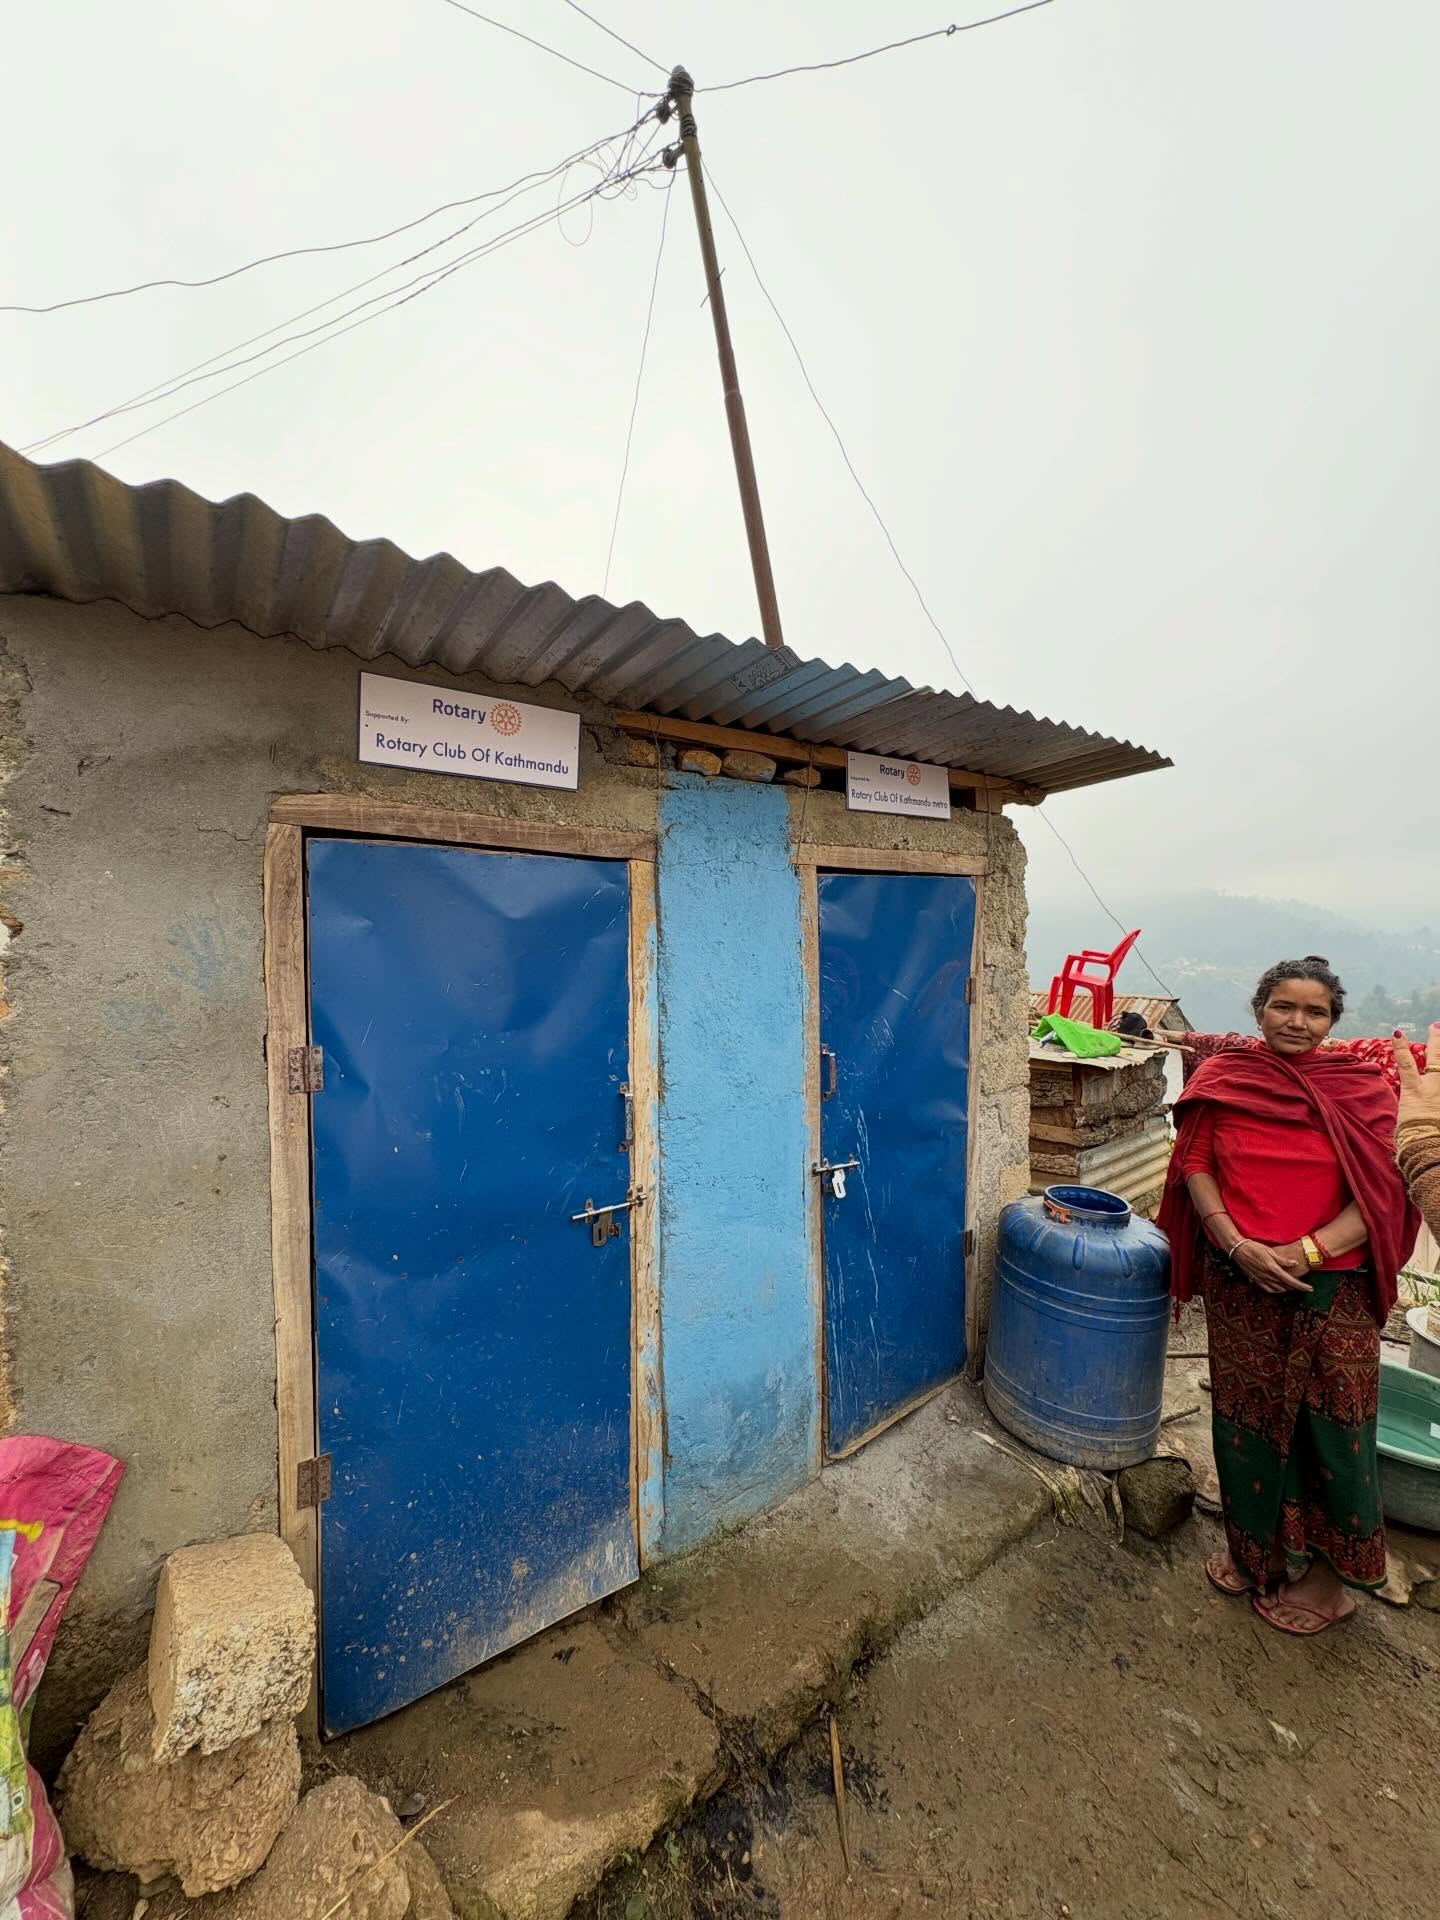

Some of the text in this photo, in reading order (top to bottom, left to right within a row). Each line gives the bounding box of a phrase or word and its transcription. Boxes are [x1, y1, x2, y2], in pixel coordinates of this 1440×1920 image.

[365, 710, 399, 722] Supported
[432, 698, 487, 724] Rotary
[376, 733, 569, 775] Rotary Club Of Kathmandu
[879, 764, 905, 779] Rotary
[851, 788, 872, 803] Rotary
[874, 791, 889, 802] Club
[890, 792, 898, 803] Of
[899, 794, 931, 807] Kathmandu
